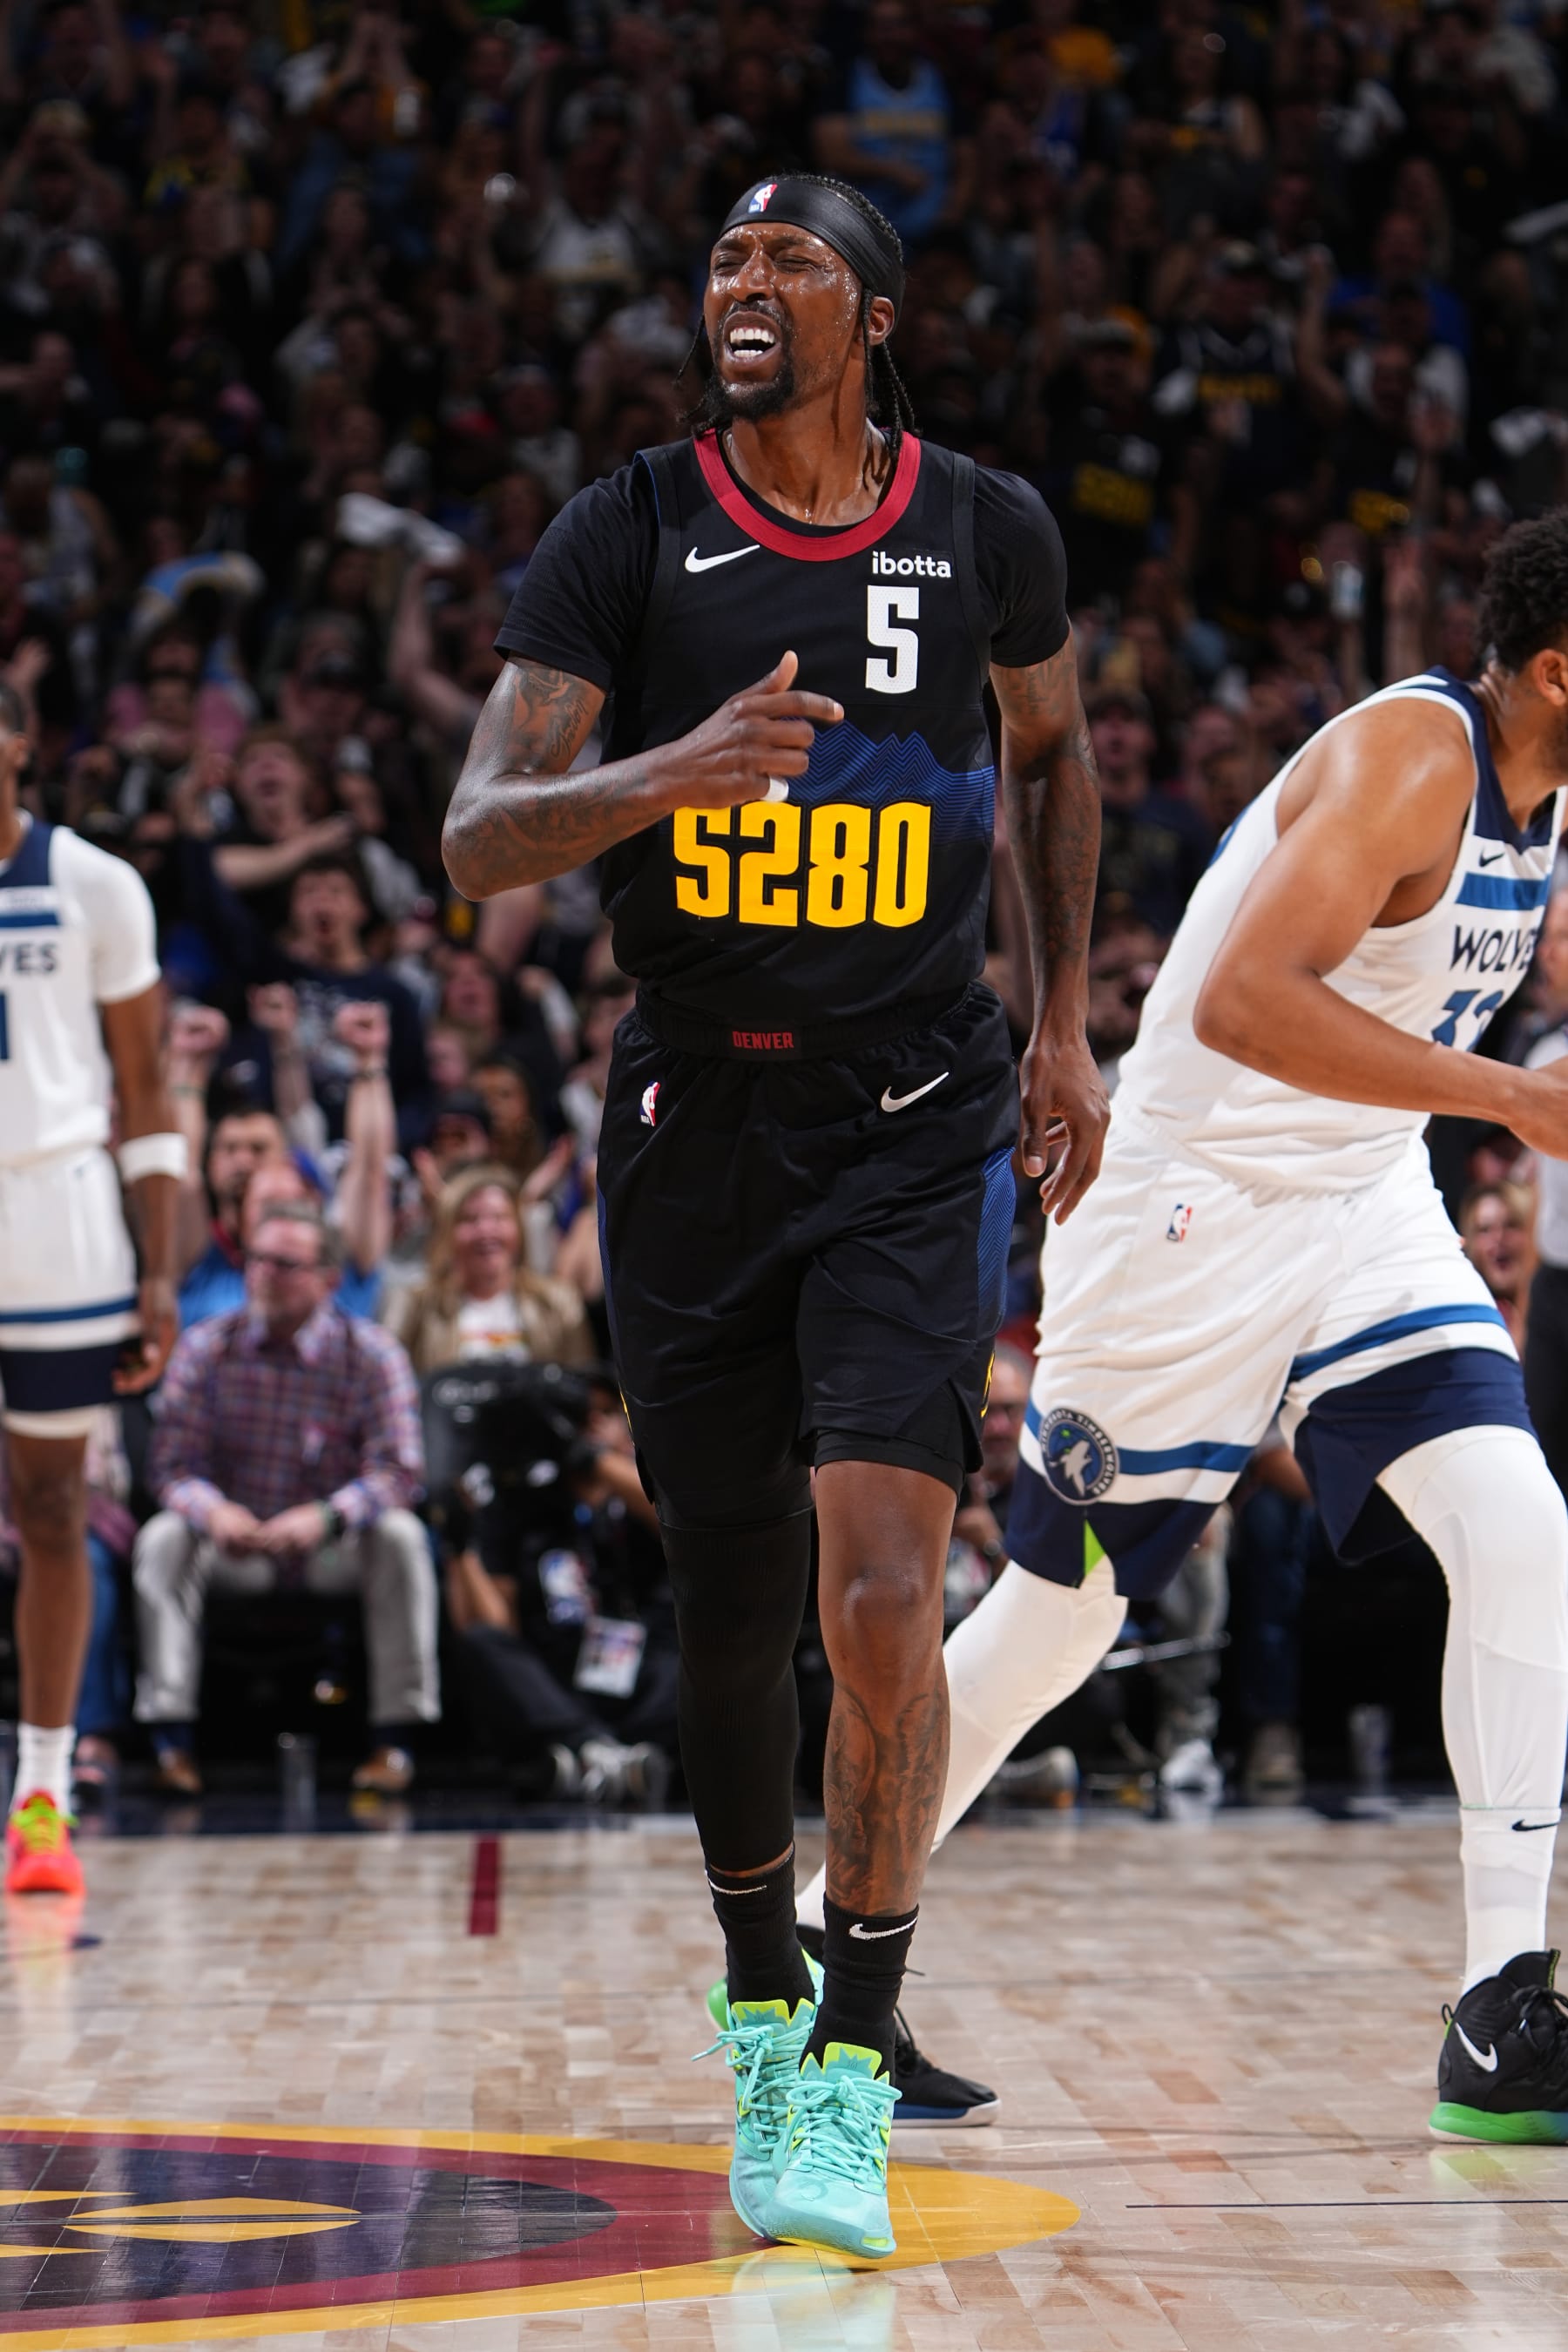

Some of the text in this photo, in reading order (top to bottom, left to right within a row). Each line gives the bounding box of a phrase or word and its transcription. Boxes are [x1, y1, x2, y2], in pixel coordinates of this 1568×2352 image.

[872, 551, 952, 578] ibotta
[865, 585, 920, 694] 5
[673, 801, 931, 928] 5280
[732, 1031, 794, 1050] DENVER
